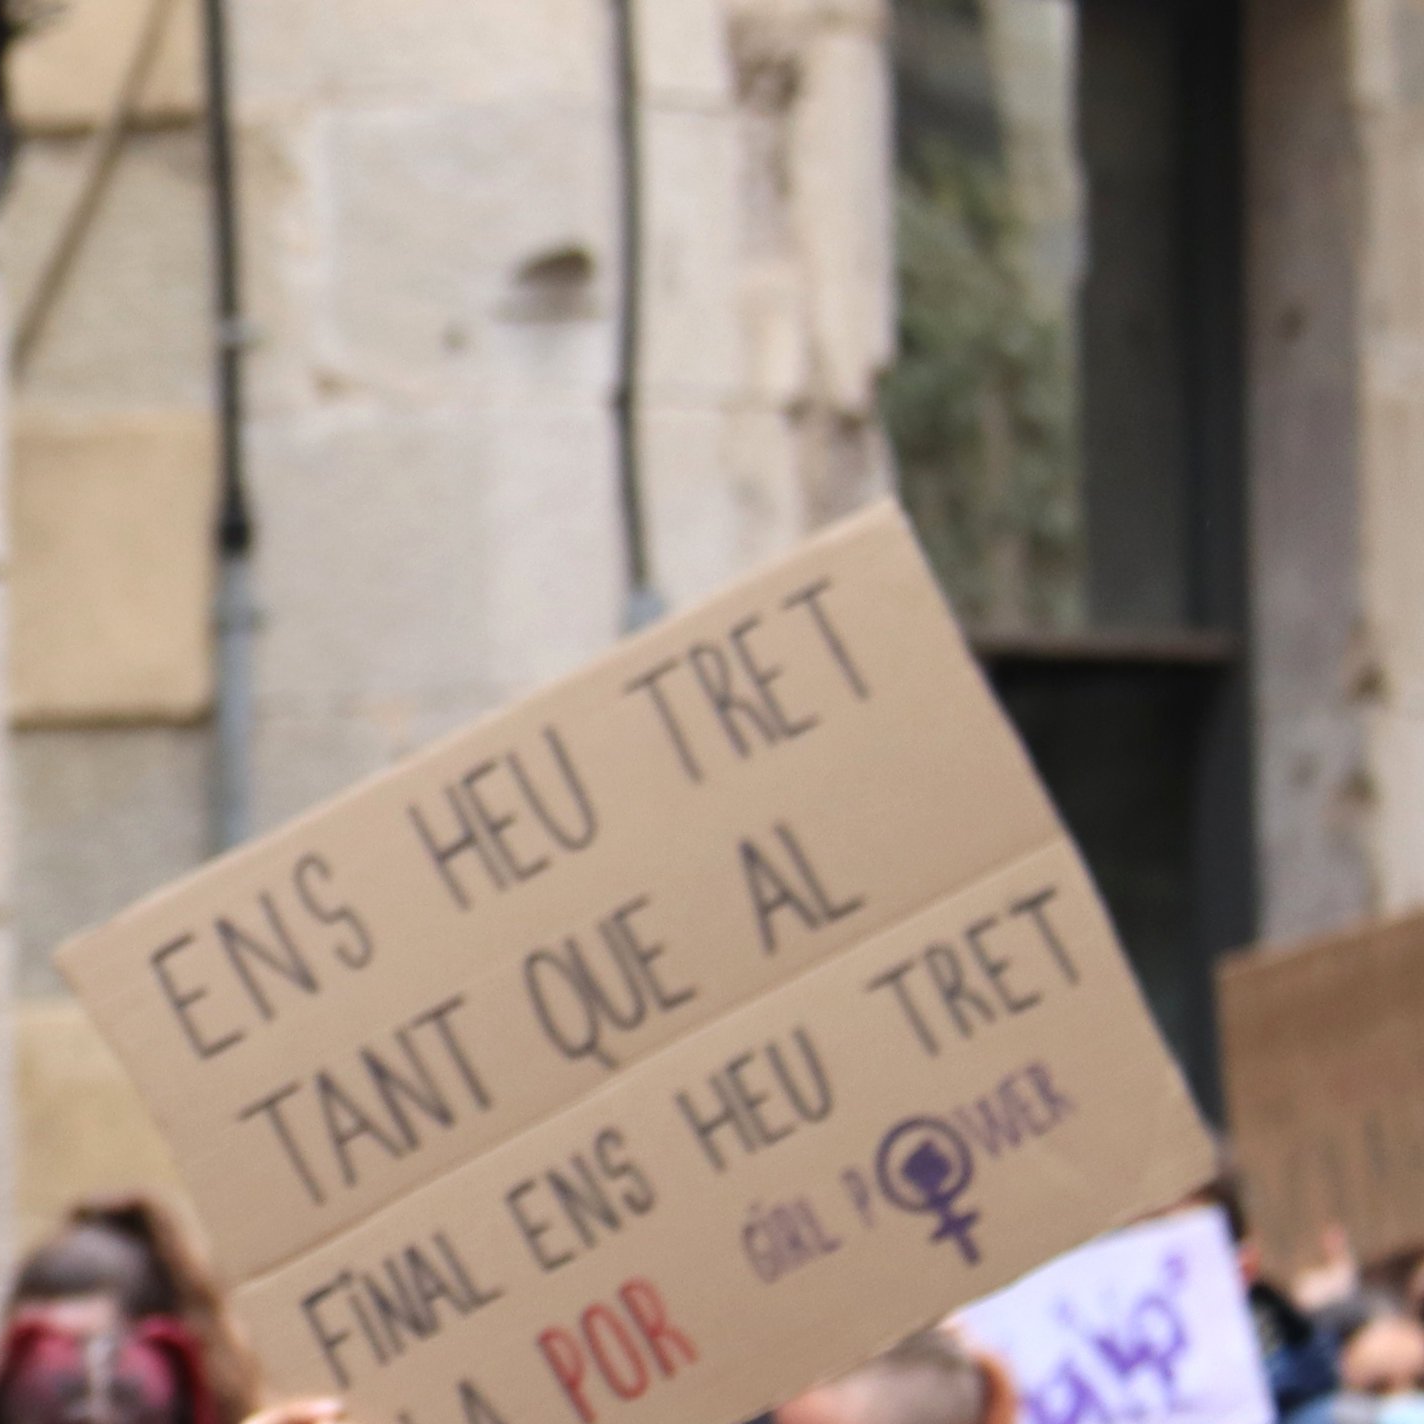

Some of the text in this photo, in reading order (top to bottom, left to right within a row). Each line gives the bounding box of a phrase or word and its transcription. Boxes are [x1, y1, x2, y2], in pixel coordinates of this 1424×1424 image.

[149, 576, 872, 1062] ENS HEU TRET
[238, 820, 868, 1207] TANT QUE AL
[503, 1126, 657, 1272] ENS
[673, 1025, 835, 1172] HEU
[866, 886, 1082, 1058] TRET
